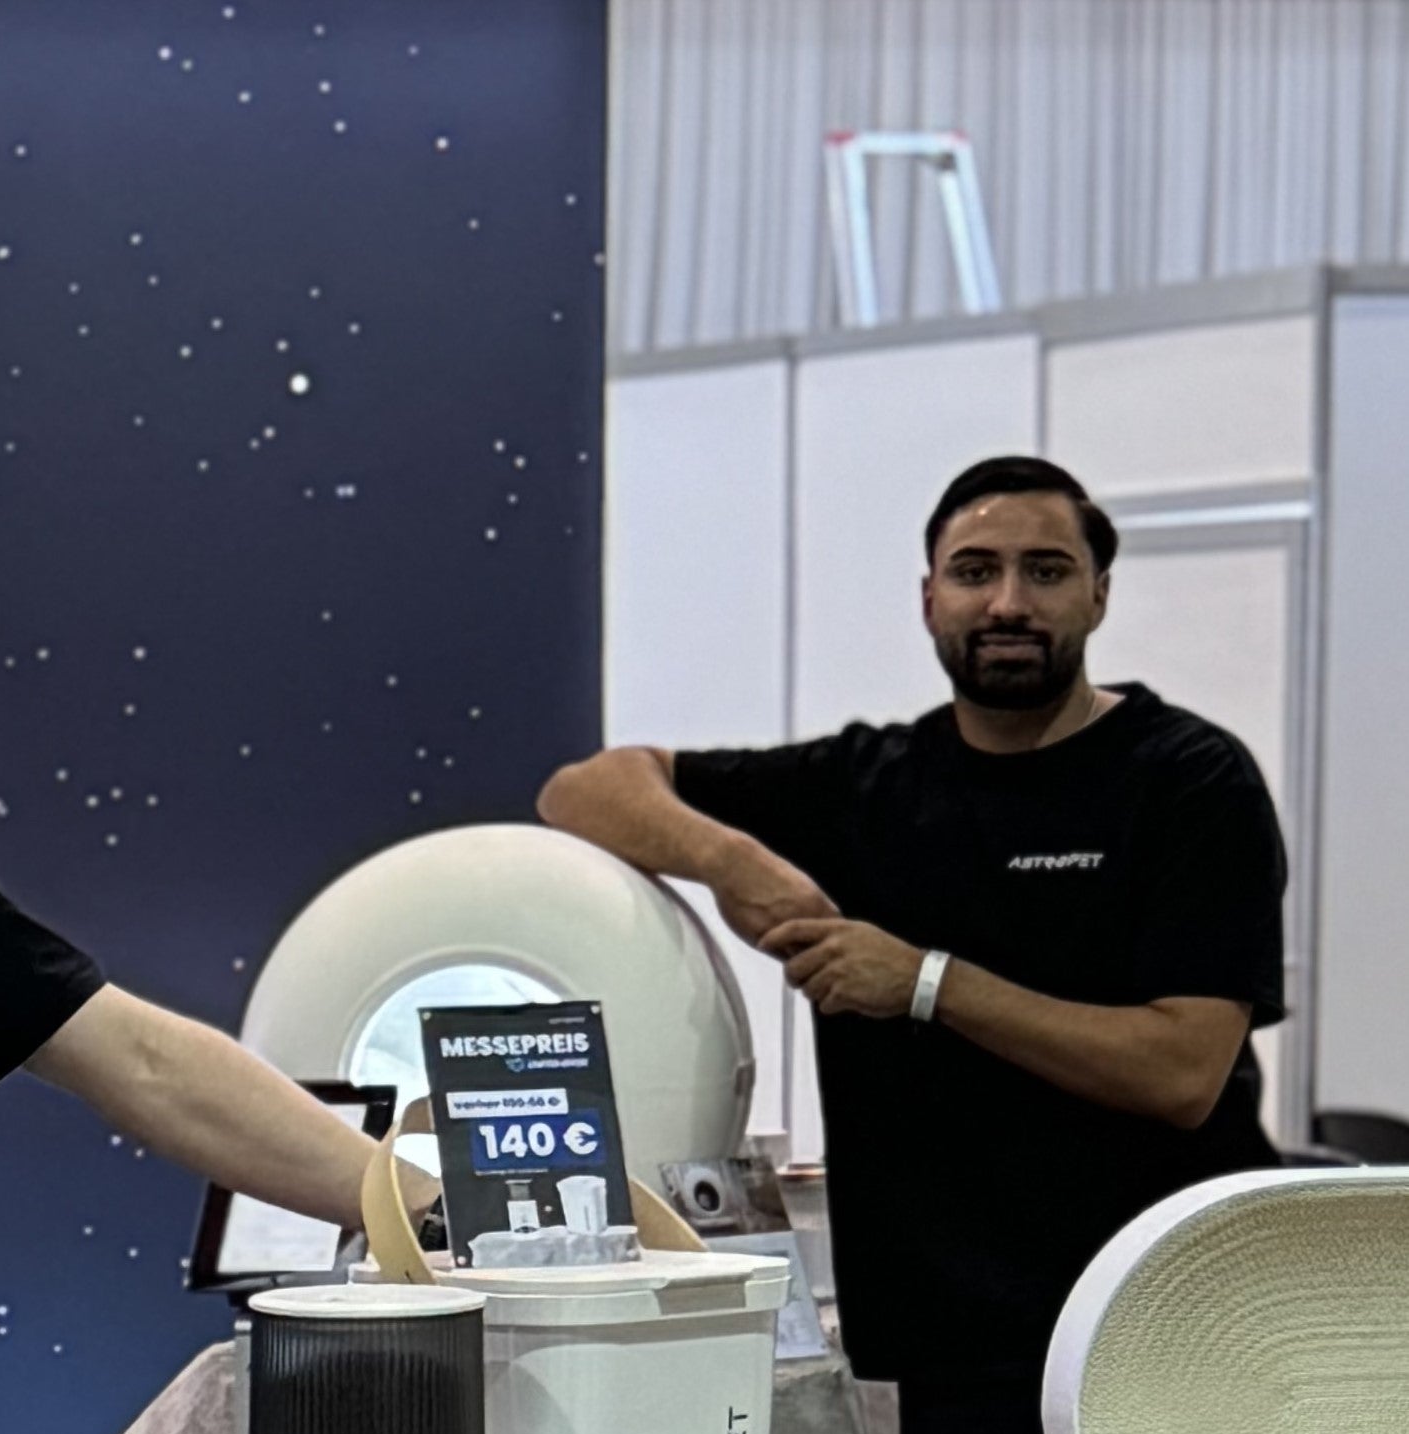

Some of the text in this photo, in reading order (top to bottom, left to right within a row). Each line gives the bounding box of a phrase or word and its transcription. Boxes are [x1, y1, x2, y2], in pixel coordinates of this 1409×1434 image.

[440, 1032, 590, 1058] MESSEPREIS
[479, 1121, 599, 1159] 140 €
